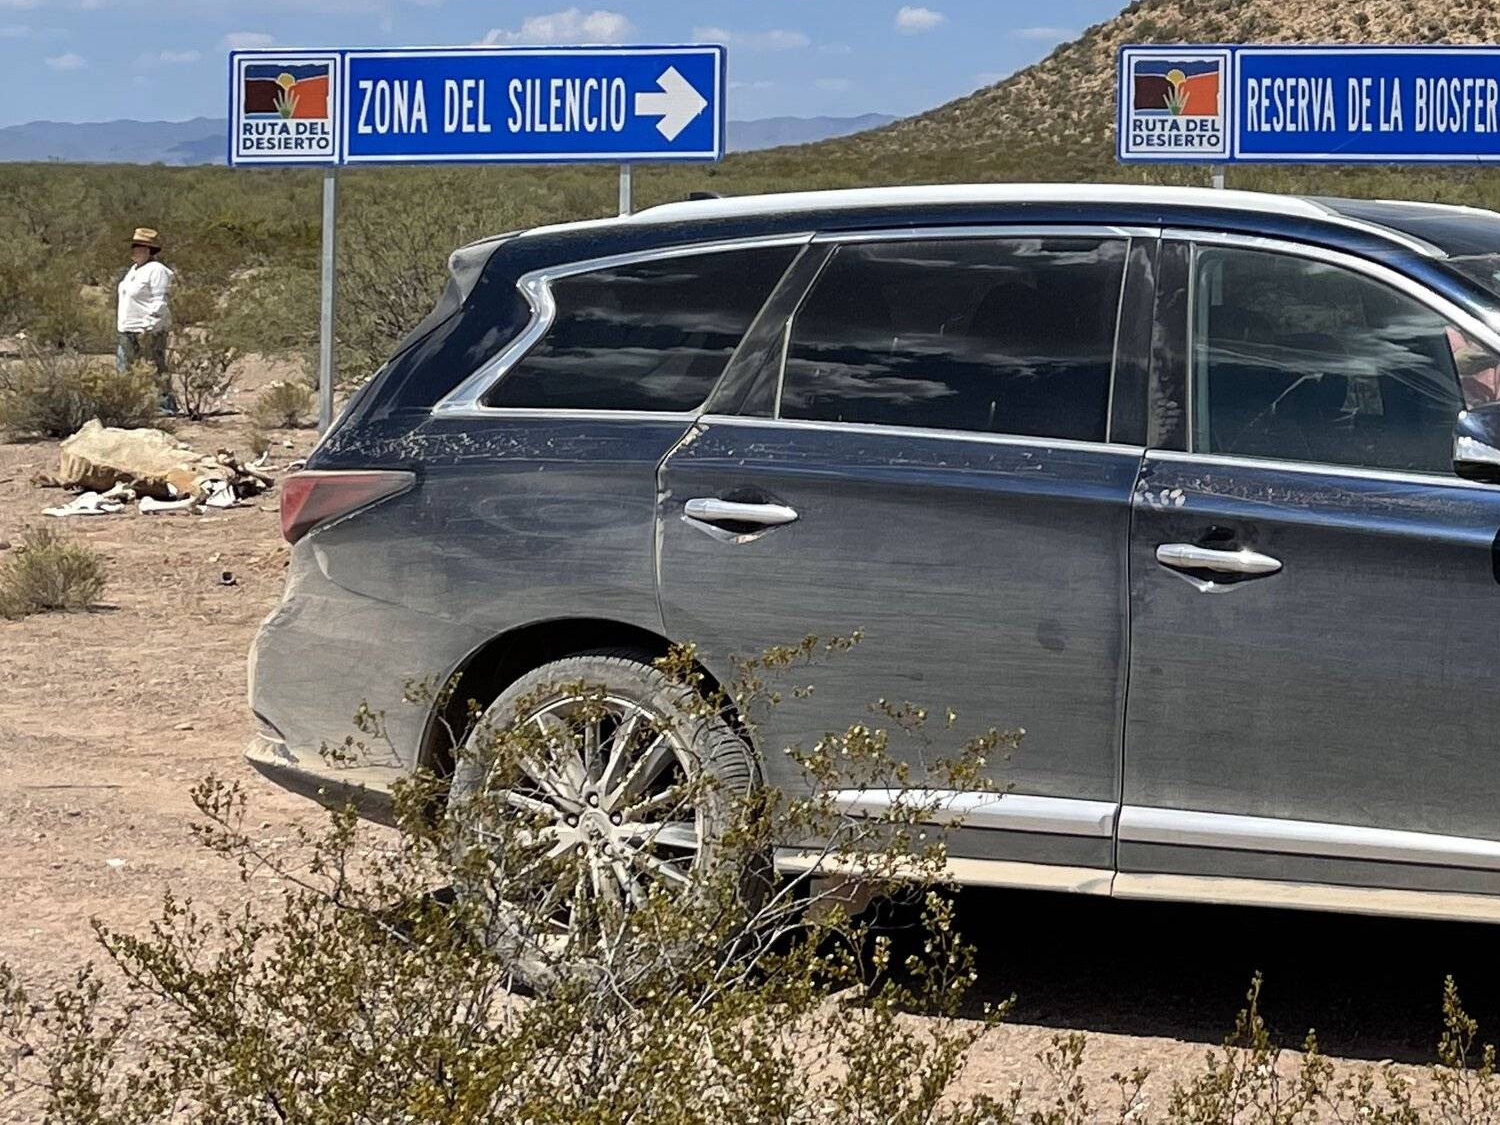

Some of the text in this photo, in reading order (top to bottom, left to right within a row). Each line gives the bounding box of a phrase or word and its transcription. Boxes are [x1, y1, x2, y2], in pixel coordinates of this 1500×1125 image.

[358, 77, 626, 134] ZONA DEL SILENCIO
[1247, 77, 1336, 132] RESERVA
[1348, 77, 1372, 132] DE
[1379, 77, 1404, 132] LA
[242, 122, 330, 136] RUTA DEL
[1132, 119, 1220, 132] RUTA DEL
[242, 137, 330, 150] DESIERTO
[1132, 134, 1220, 147] DESIERTO
